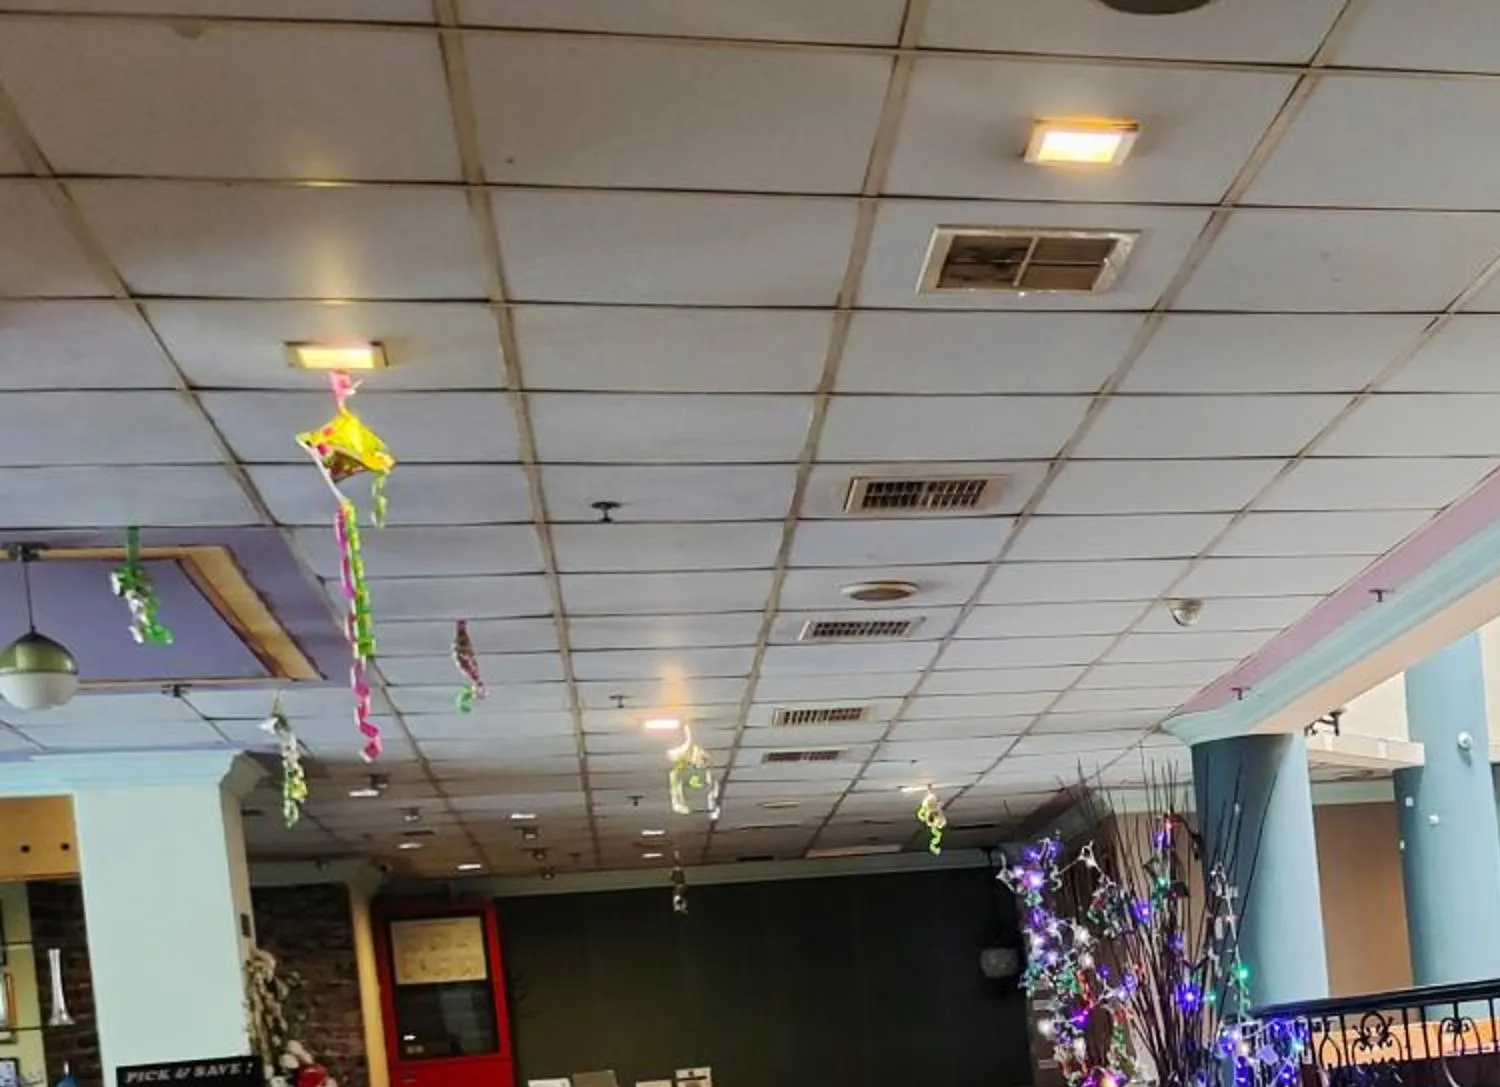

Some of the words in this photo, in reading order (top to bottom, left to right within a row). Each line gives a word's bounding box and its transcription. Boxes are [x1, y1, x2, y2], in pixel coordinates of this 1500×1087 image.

[126, 1069, 170, 1083] PICK
[175, 1066, 192, 1079] &
[193, 1062, 242, 1078] SAVE
